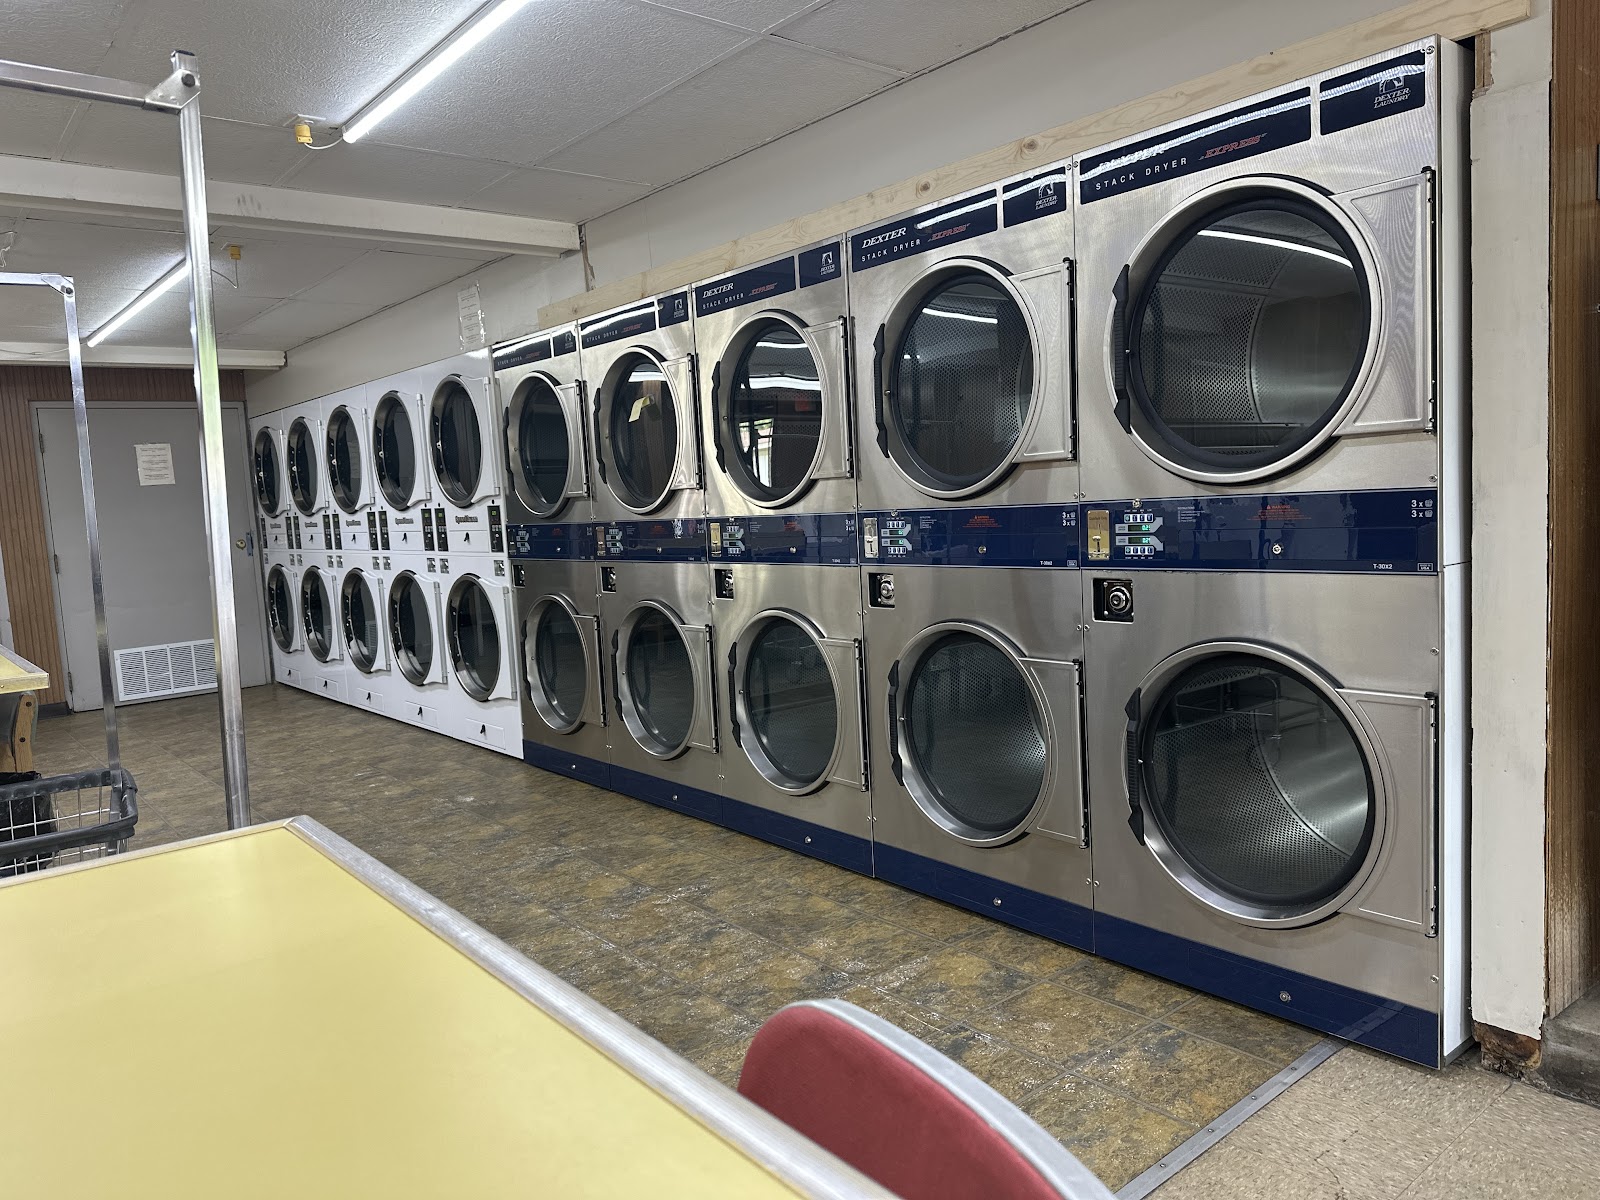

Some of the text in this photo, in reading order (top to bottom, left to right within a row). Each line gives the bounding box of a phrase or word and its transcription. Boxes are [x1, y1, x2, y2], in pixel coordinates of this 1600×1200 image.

[1374, 87, 1411, 103] DEXTER
[1374, 93, 1411, 109] LAUNDRY
[1096, 134, 1262, 191] STACK DRYER EXPRESS
[862, 227, 907, 249] DEXTER
[862, 249, 888, 262] STACK
[893, 238, 921, 253] DRYER
[702, 282, 735, 299] DEXTER
[702, 300, 721, 310] STACK
[724, 293, 744, 304] DRYER
[1411, 500, 1418, 508] 3
[1411, 510, 1418, 518] 3
